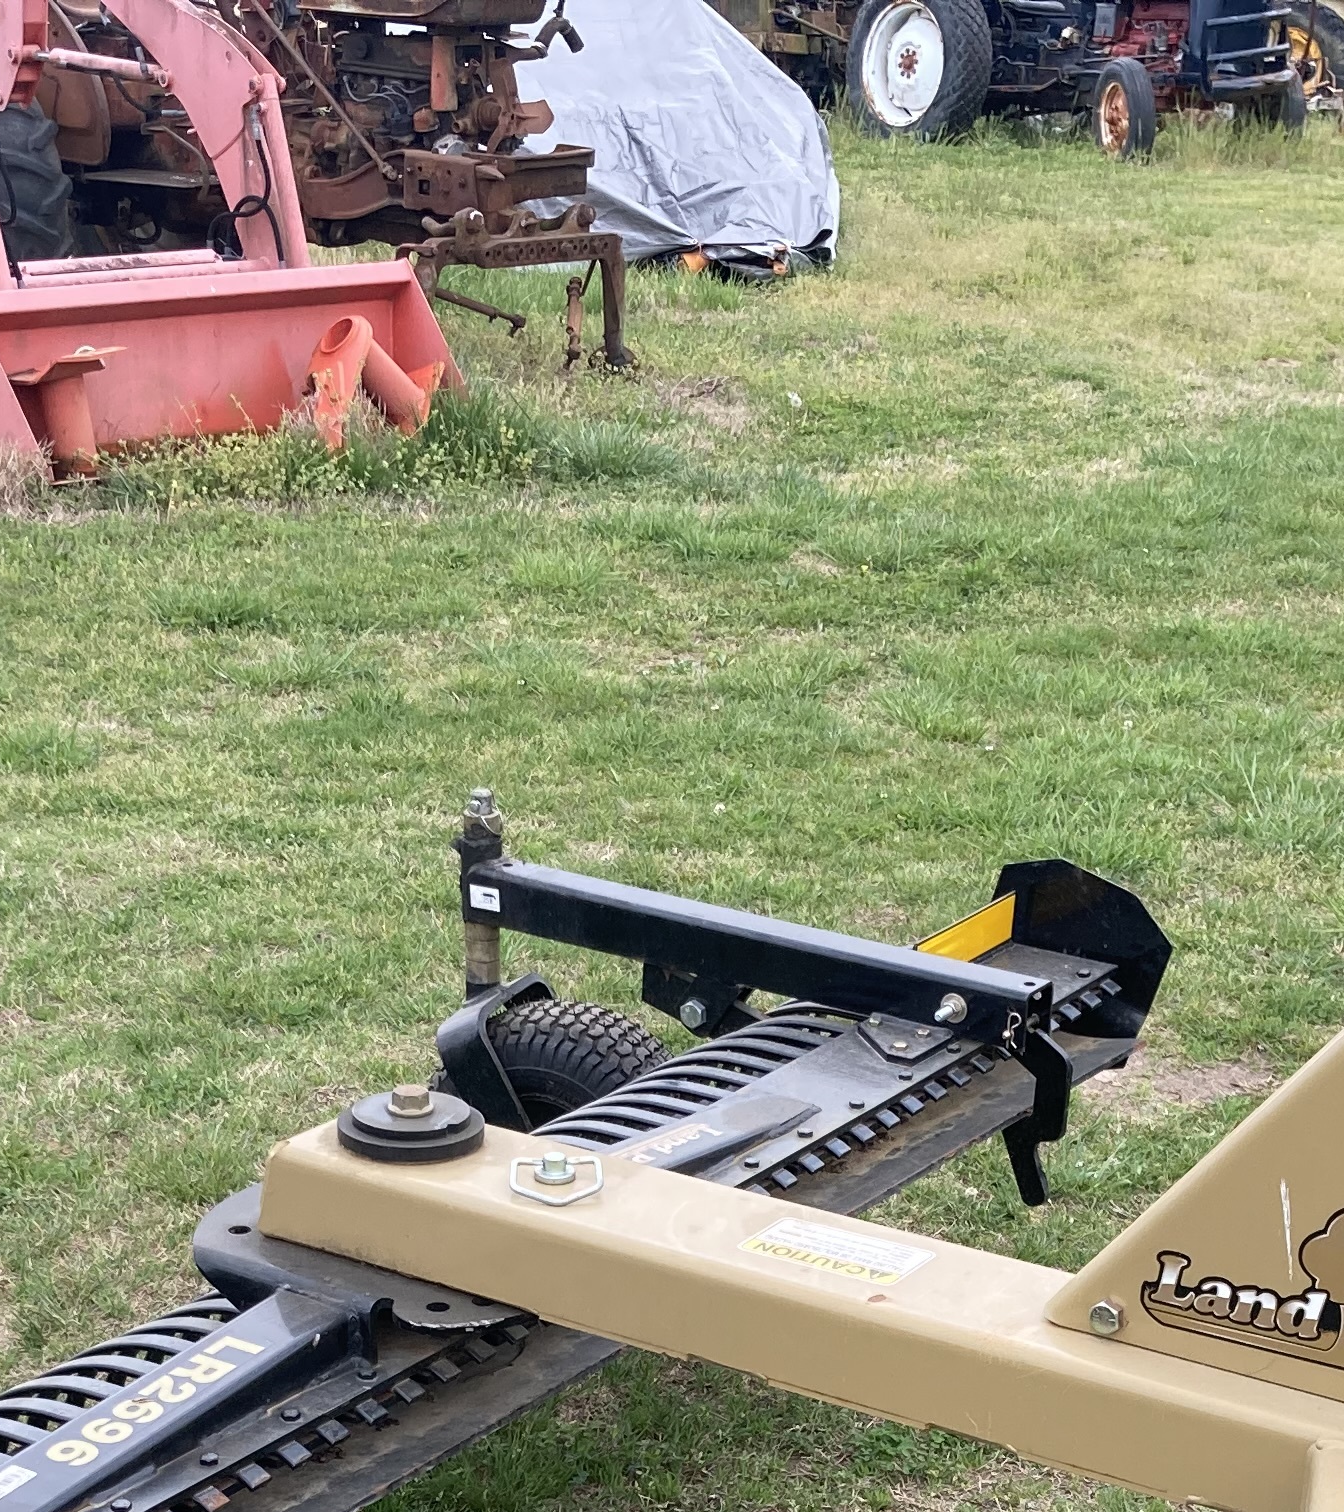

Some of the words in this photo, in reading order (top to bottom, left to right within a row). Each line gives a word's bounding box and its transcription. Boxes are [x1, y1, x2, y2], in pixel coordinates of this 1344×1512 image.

[654, 1123, 723, 1155] Land
[755, 1241, 866, 1275] CAUTION
[1149, 1251, 1331, 1341] Land
[46, 1335, 266, 1467] LR2696
